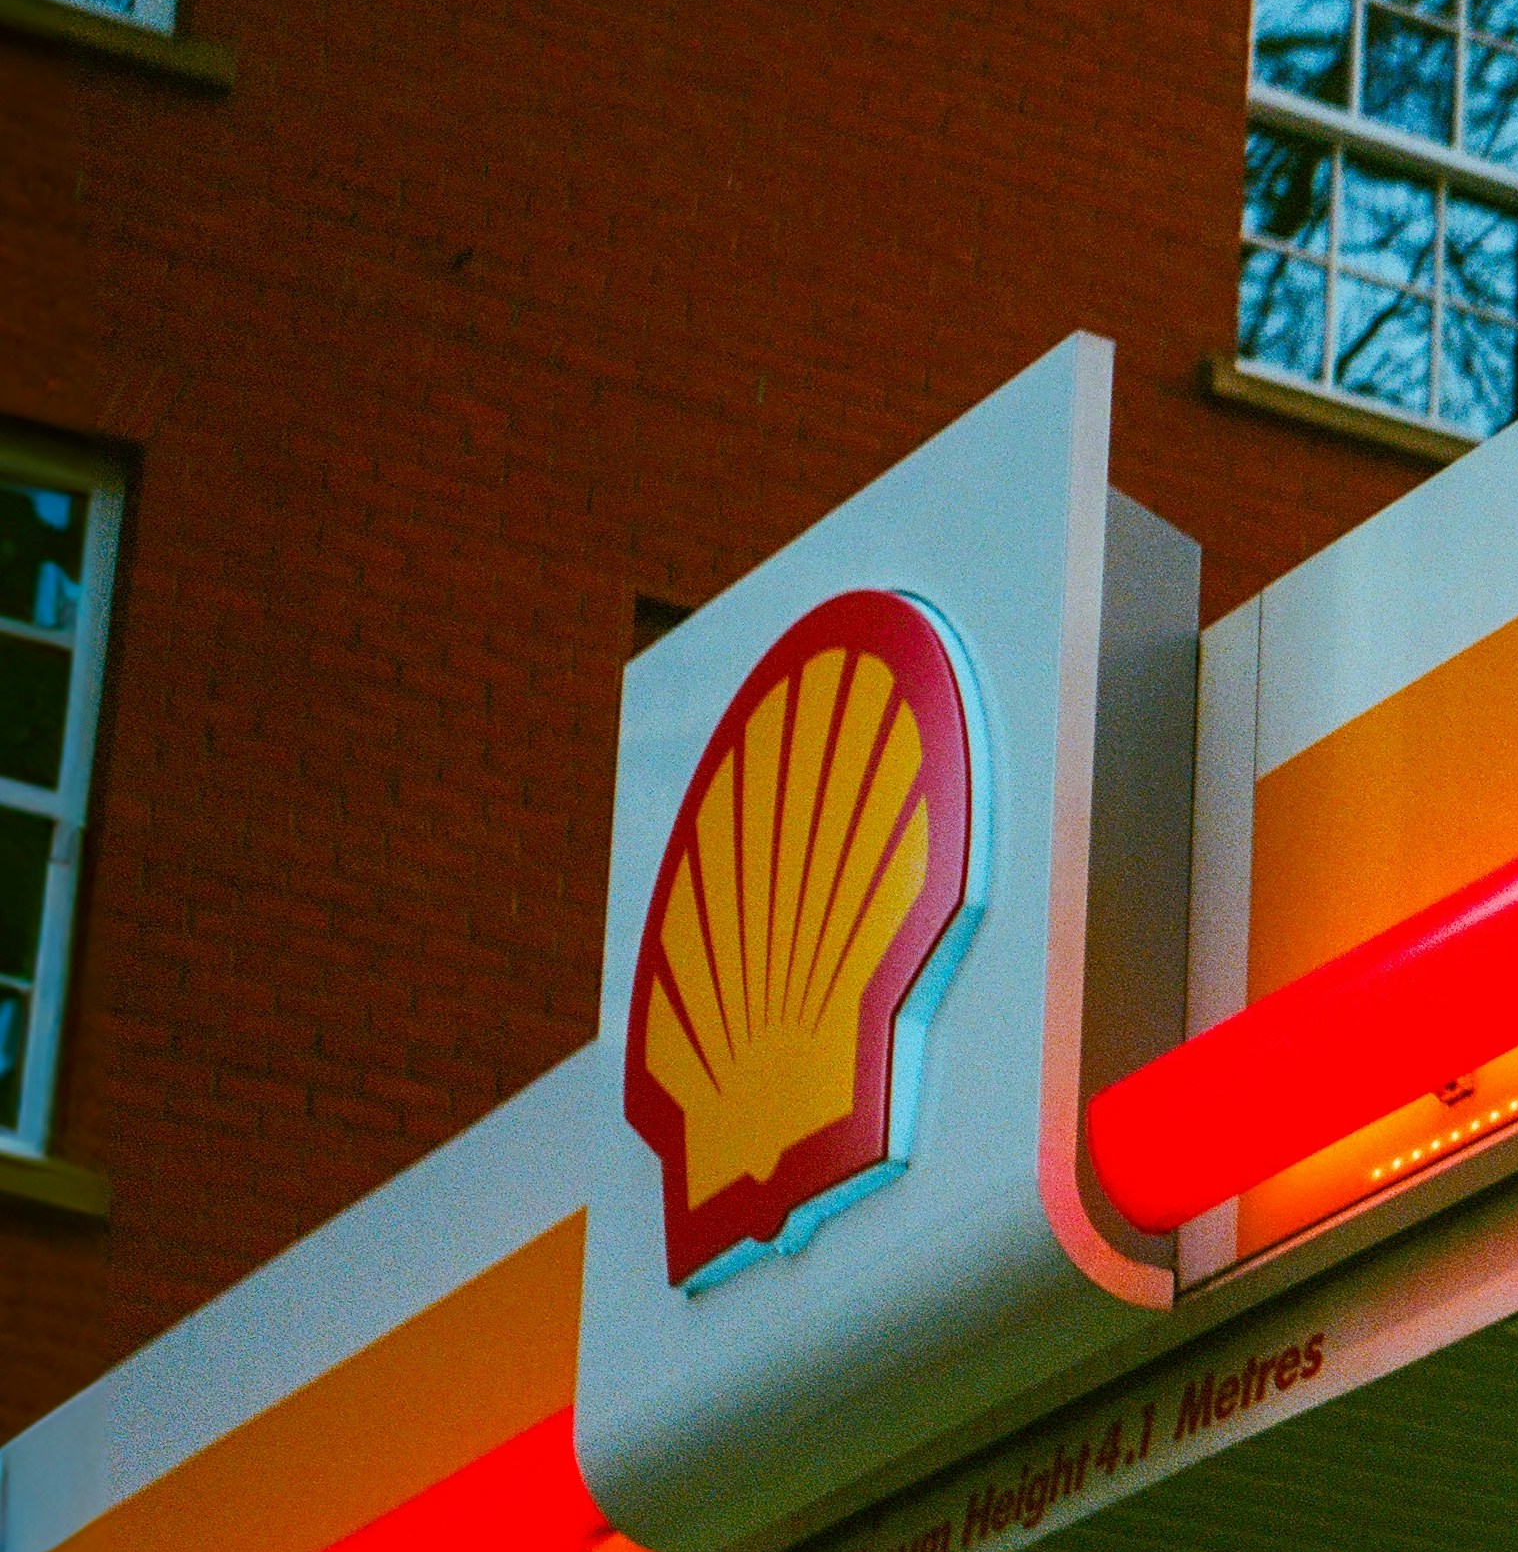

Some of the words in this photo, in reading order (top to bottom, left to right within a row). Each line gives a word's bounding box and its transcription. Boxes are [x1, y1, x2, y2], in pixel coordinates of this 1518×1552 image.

[961, 1442, 1091, 1549] Height
[1095, 1403, 1156, 1476] 4.1
[1173, 1332, 1325, 1442] Metres
